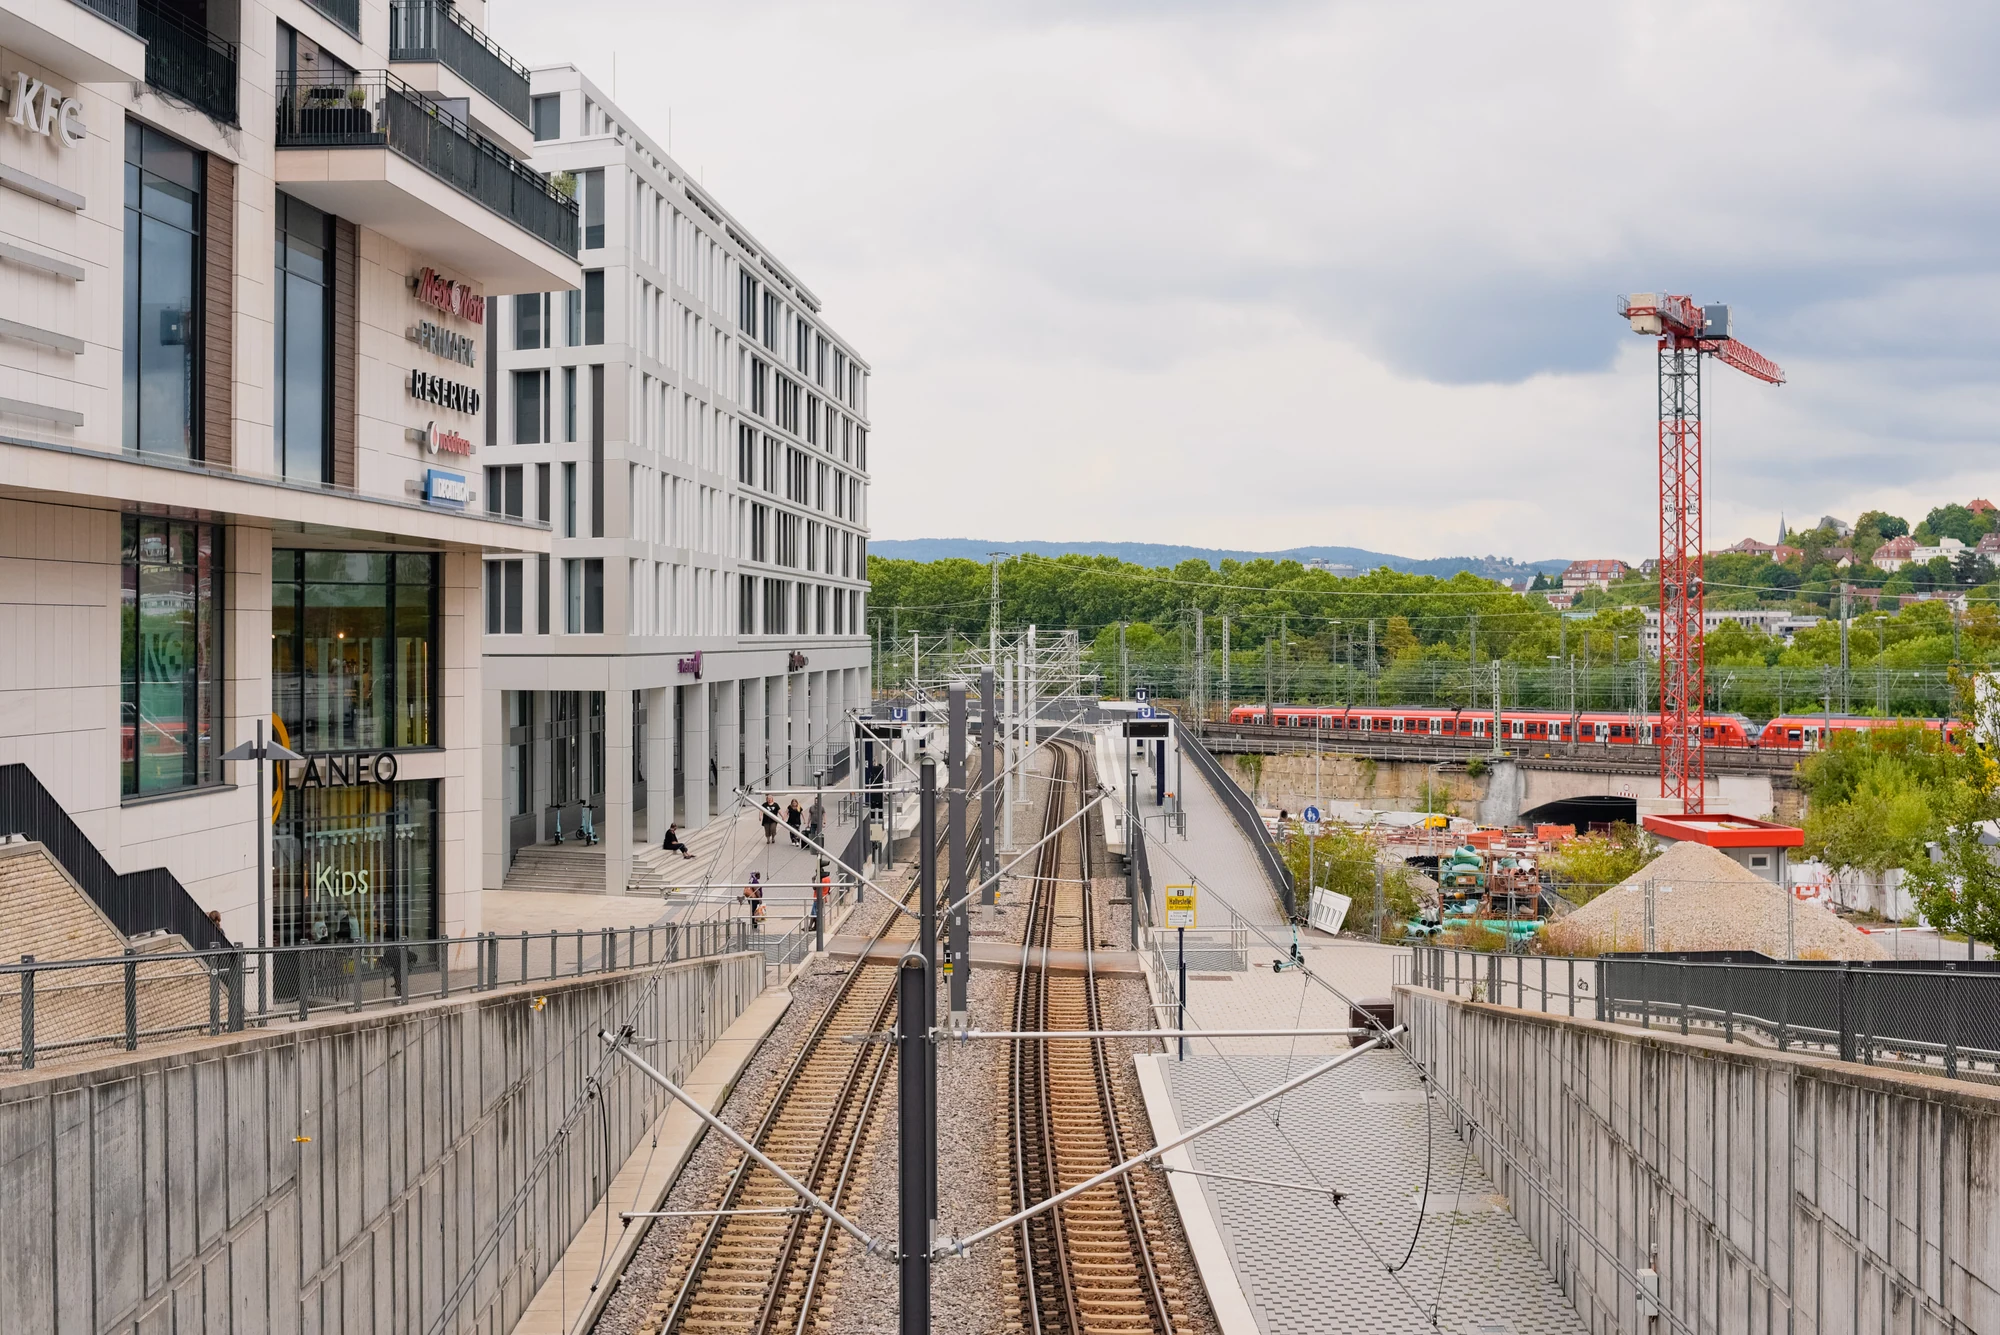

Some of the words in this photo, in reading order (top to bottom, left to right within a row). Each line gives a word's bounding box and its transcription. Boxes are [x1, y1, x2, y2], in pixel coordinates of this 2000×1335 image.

[12, 71, 79, 149] KFC
[420, 320, 476, 368] PRIMARK
[412, 369, 480, 415] RESERVED
[439, 430, 471, 457] vodafone
[435, 478, 470, 502] DECATHLON
[1137, 691, 1146, 701] U
[894, 708, 903, 718] U
[1142, 708, 1151, 718] U
